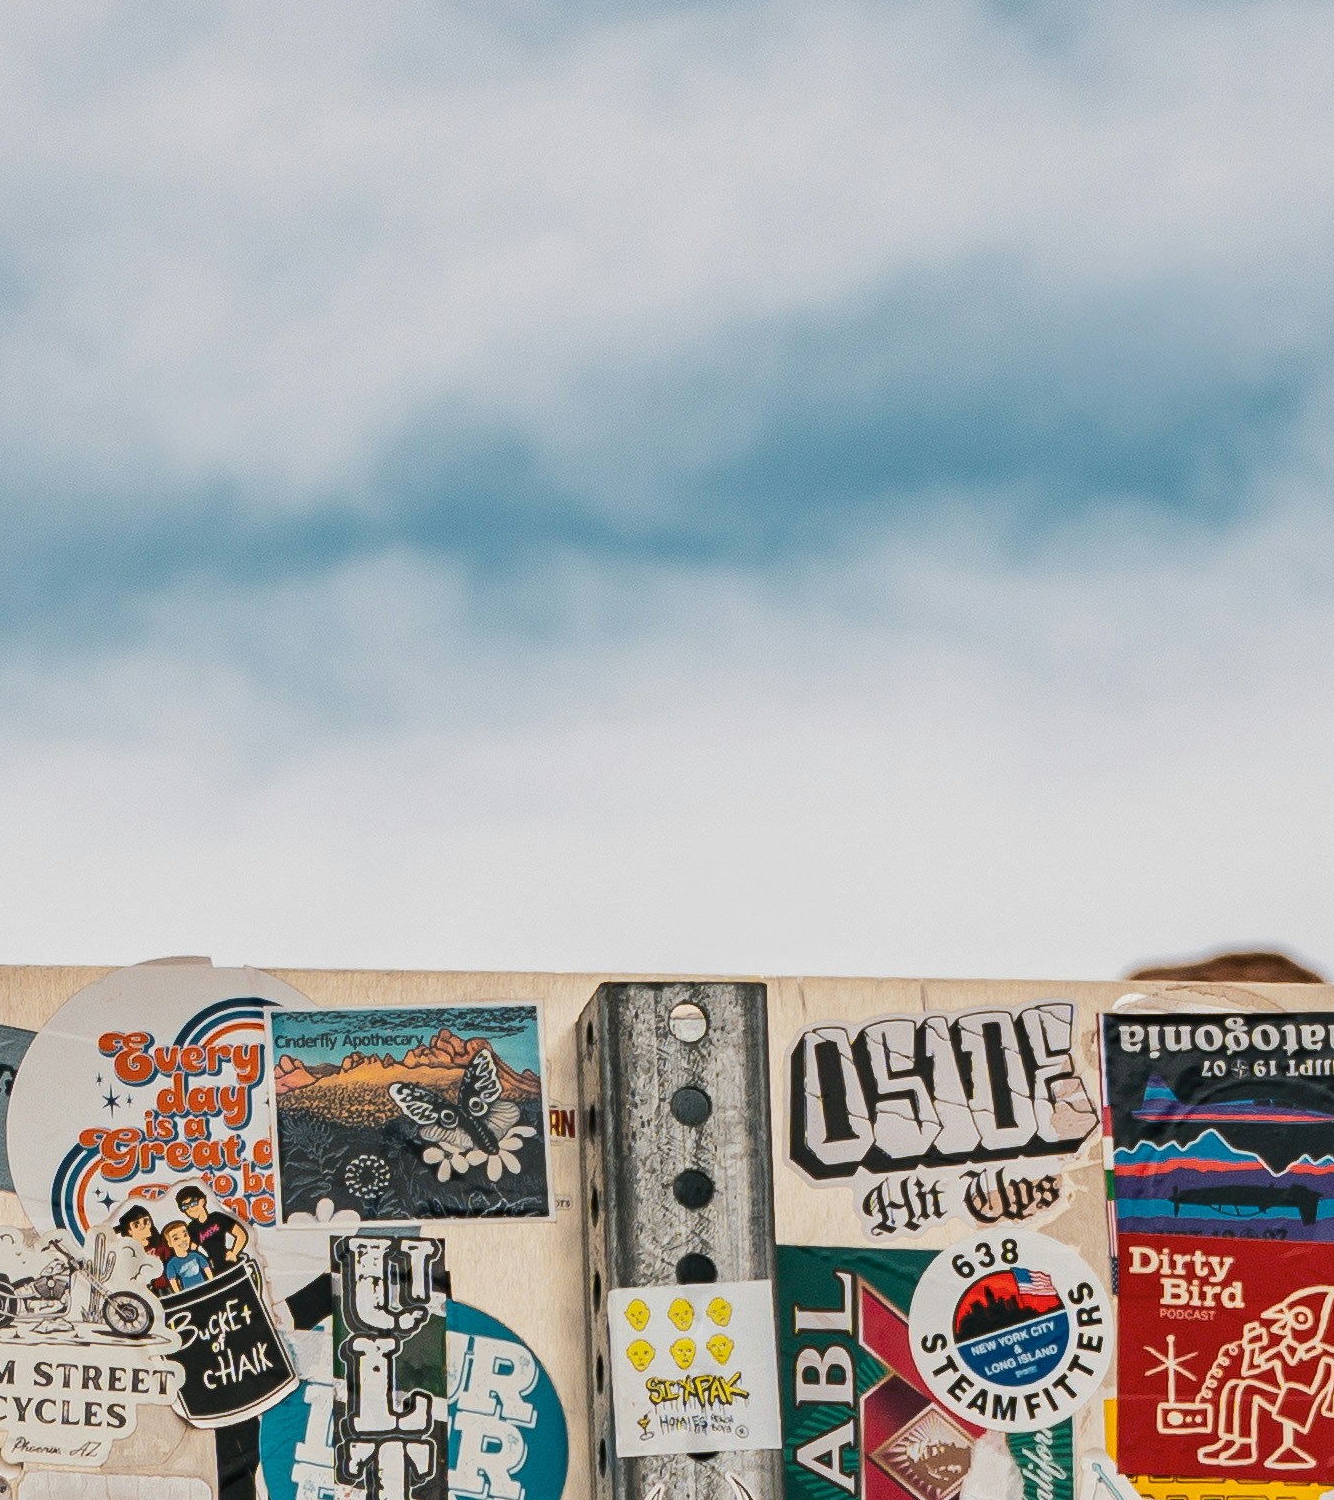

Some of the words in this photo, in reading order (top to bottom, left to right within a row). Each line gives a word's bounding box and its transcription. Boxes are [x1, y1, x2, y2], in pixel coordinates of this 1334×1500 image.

[274, 1034, 338, 1050] Cinderfly
[342, 1033, 424, 1050] Apothecary
[98, 1031, 266, 1088] Every
[1201, 1060, 1226, 1077] 07
[1254, 1060, 1276, 1077] 19
[156, 1071, 252, 1131] day
[144, 1110, 177, 1141] is
[184, 1116, 211, 1140] a
[78, 1127, 246, 1181] Great
[862, 1176, 948, 1236] Hit
[952, 1238, 1018, 1278] 638
[1129, 1246, 1234, 1282] Dirty
[1160, 1277, 1245, 1309] Bird
[1159, 1308, 1216, 1321] PODCAST
[921, 1281, 1103, 1421] STEAMFITTERS
[970, 1340, 996, 1356] NEW
[998, 1329, 1029, 1347] YORK
[1031, 1321, 1054, 1337] CITY
[1014, 1344, 1022, 1354] &
[984, 1358, 1016, 1376] LONG
[1017, 1344, 1057, 1365] ISLAND
[33, 1361, 175, 1395] STREET
[794, 1269, 855, 1496] ABL
[11, 1436, 62, 1455] Phoenix
[69, 1440, 102, 1458] AZ
